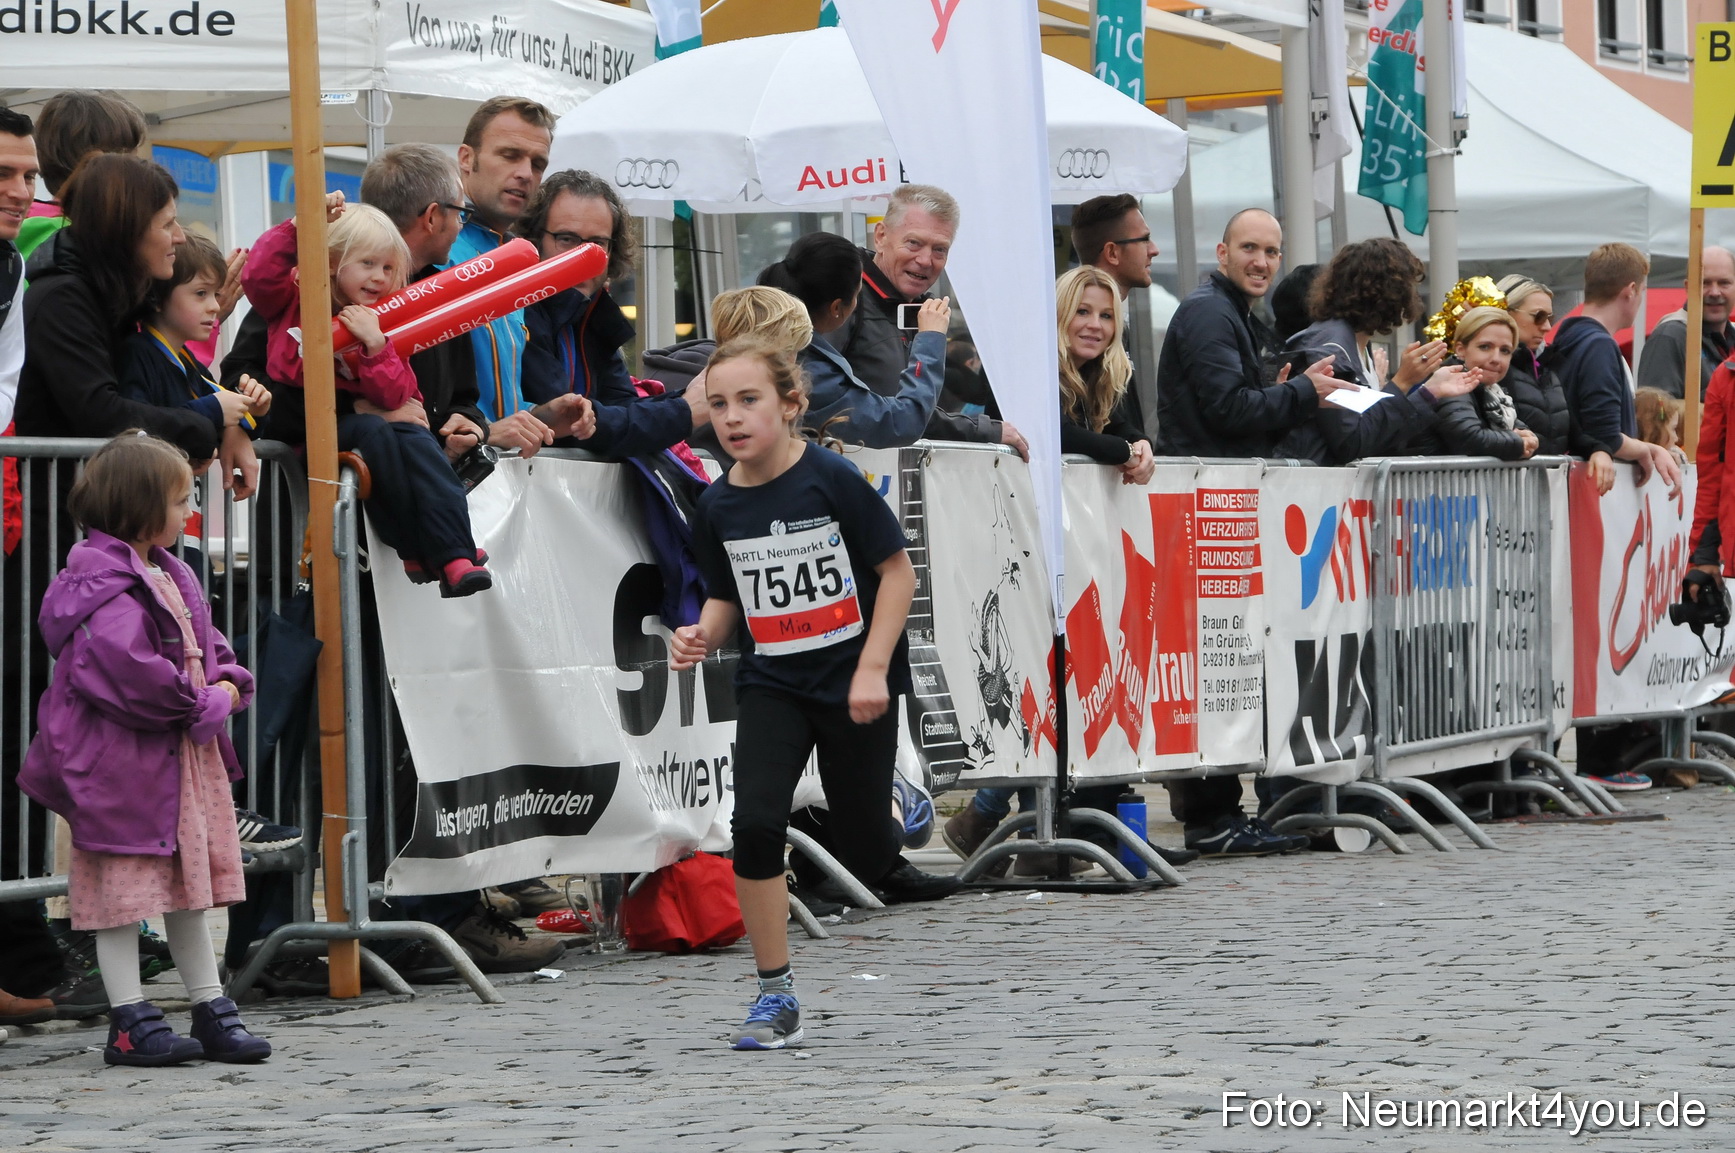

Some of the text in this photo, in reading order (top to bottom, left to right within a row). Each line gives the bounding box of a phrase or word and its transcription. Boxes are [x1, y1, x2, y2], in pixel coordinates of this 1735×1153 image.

[406, 2, 635, 84] Von uns, für uns: Audi BKK
[797, 157, 887, 192] Audi
[406, 278, 444, 302] BKK
[412, 310, 498, 354] Audi BKK
[730, 541, 824, 563] PARTL Neumarkt
[742, 554, 843, 610] 7545
[779, 618, 812, 635] Mia
[1203, 614, 1228, 630] Braun
[1203, 633, 1214, 648] Am
[1203, 652, 1236, 667] D-92318
[1080, 662, 1113, 730] Braun
[1203, 679, 1215, 694] Tel.
[1203, 698, 1215, 712] Fax
[510, 788, 594, 820] verbinden
